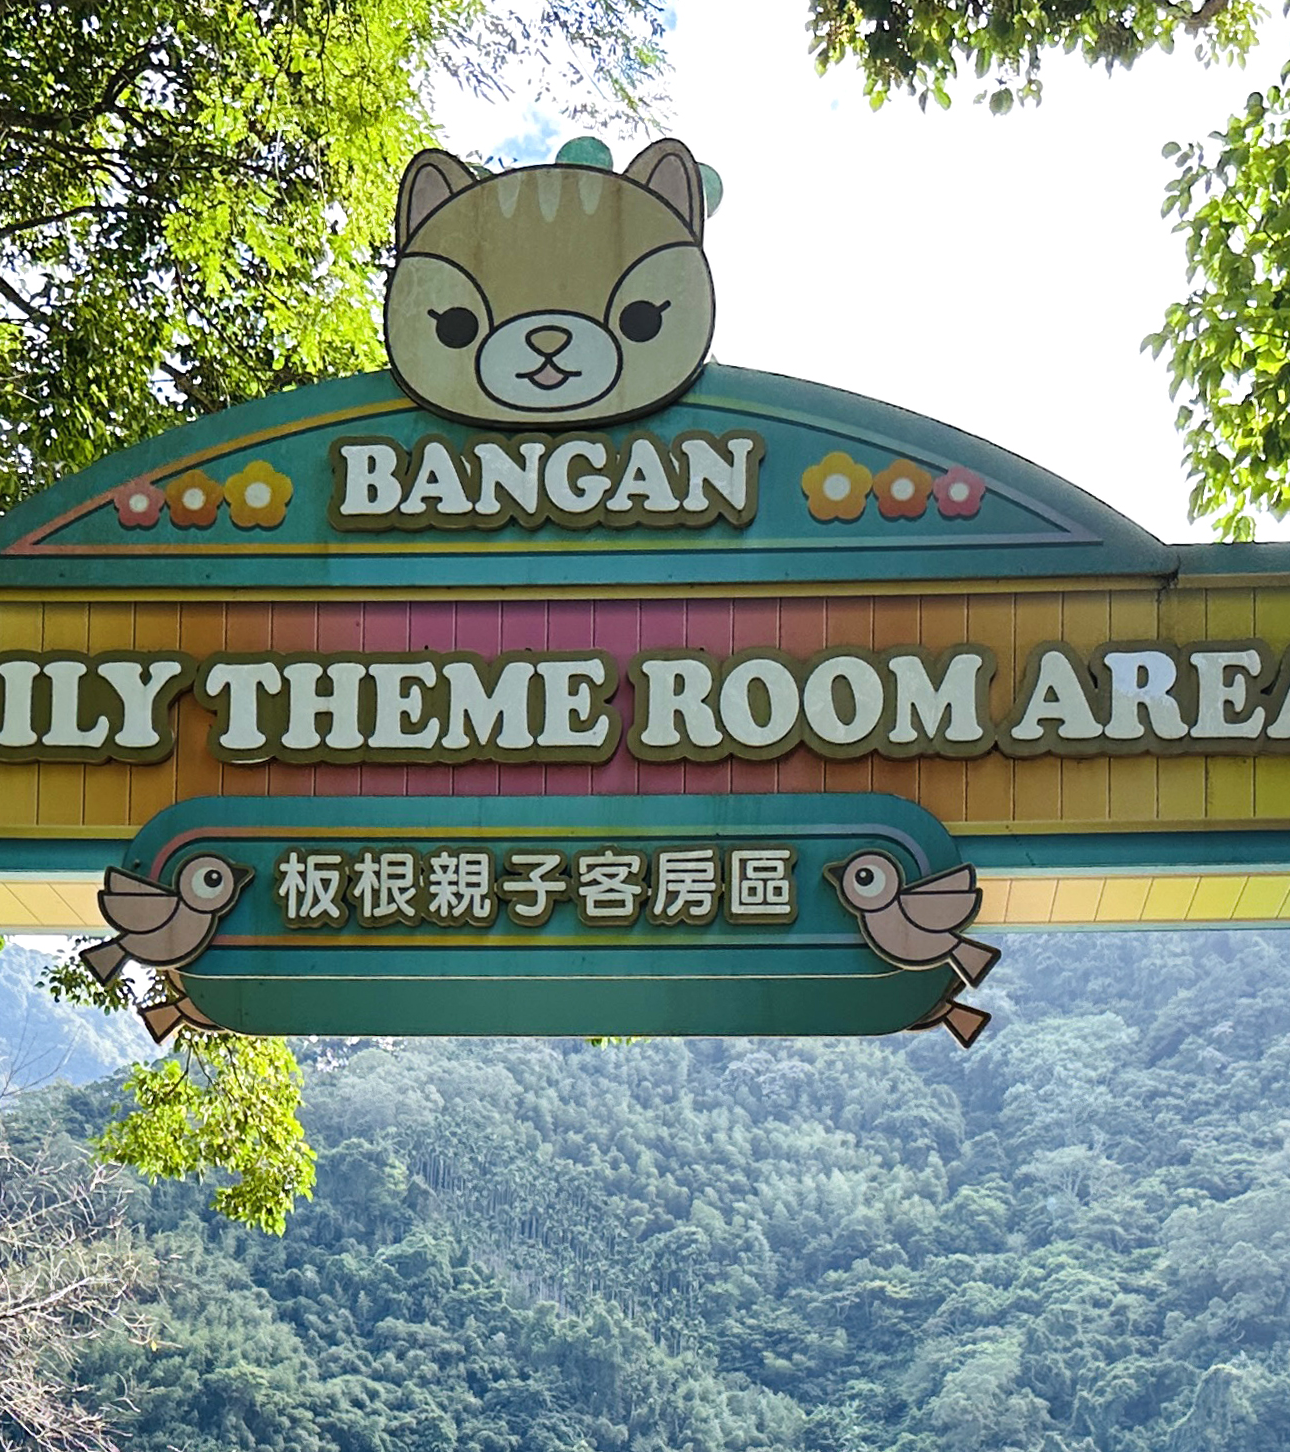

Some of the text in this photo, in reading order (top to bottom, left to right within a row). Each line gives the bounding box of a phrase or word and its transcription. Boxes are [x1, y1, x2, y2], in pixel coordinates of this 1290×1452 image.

[340, 439, 753, 515] BANGAN
[206, 660, 609, 750] THEME
[641, 654, 984, 747] ROOM
[279, 849, 791, 918] 板根親子客房區
